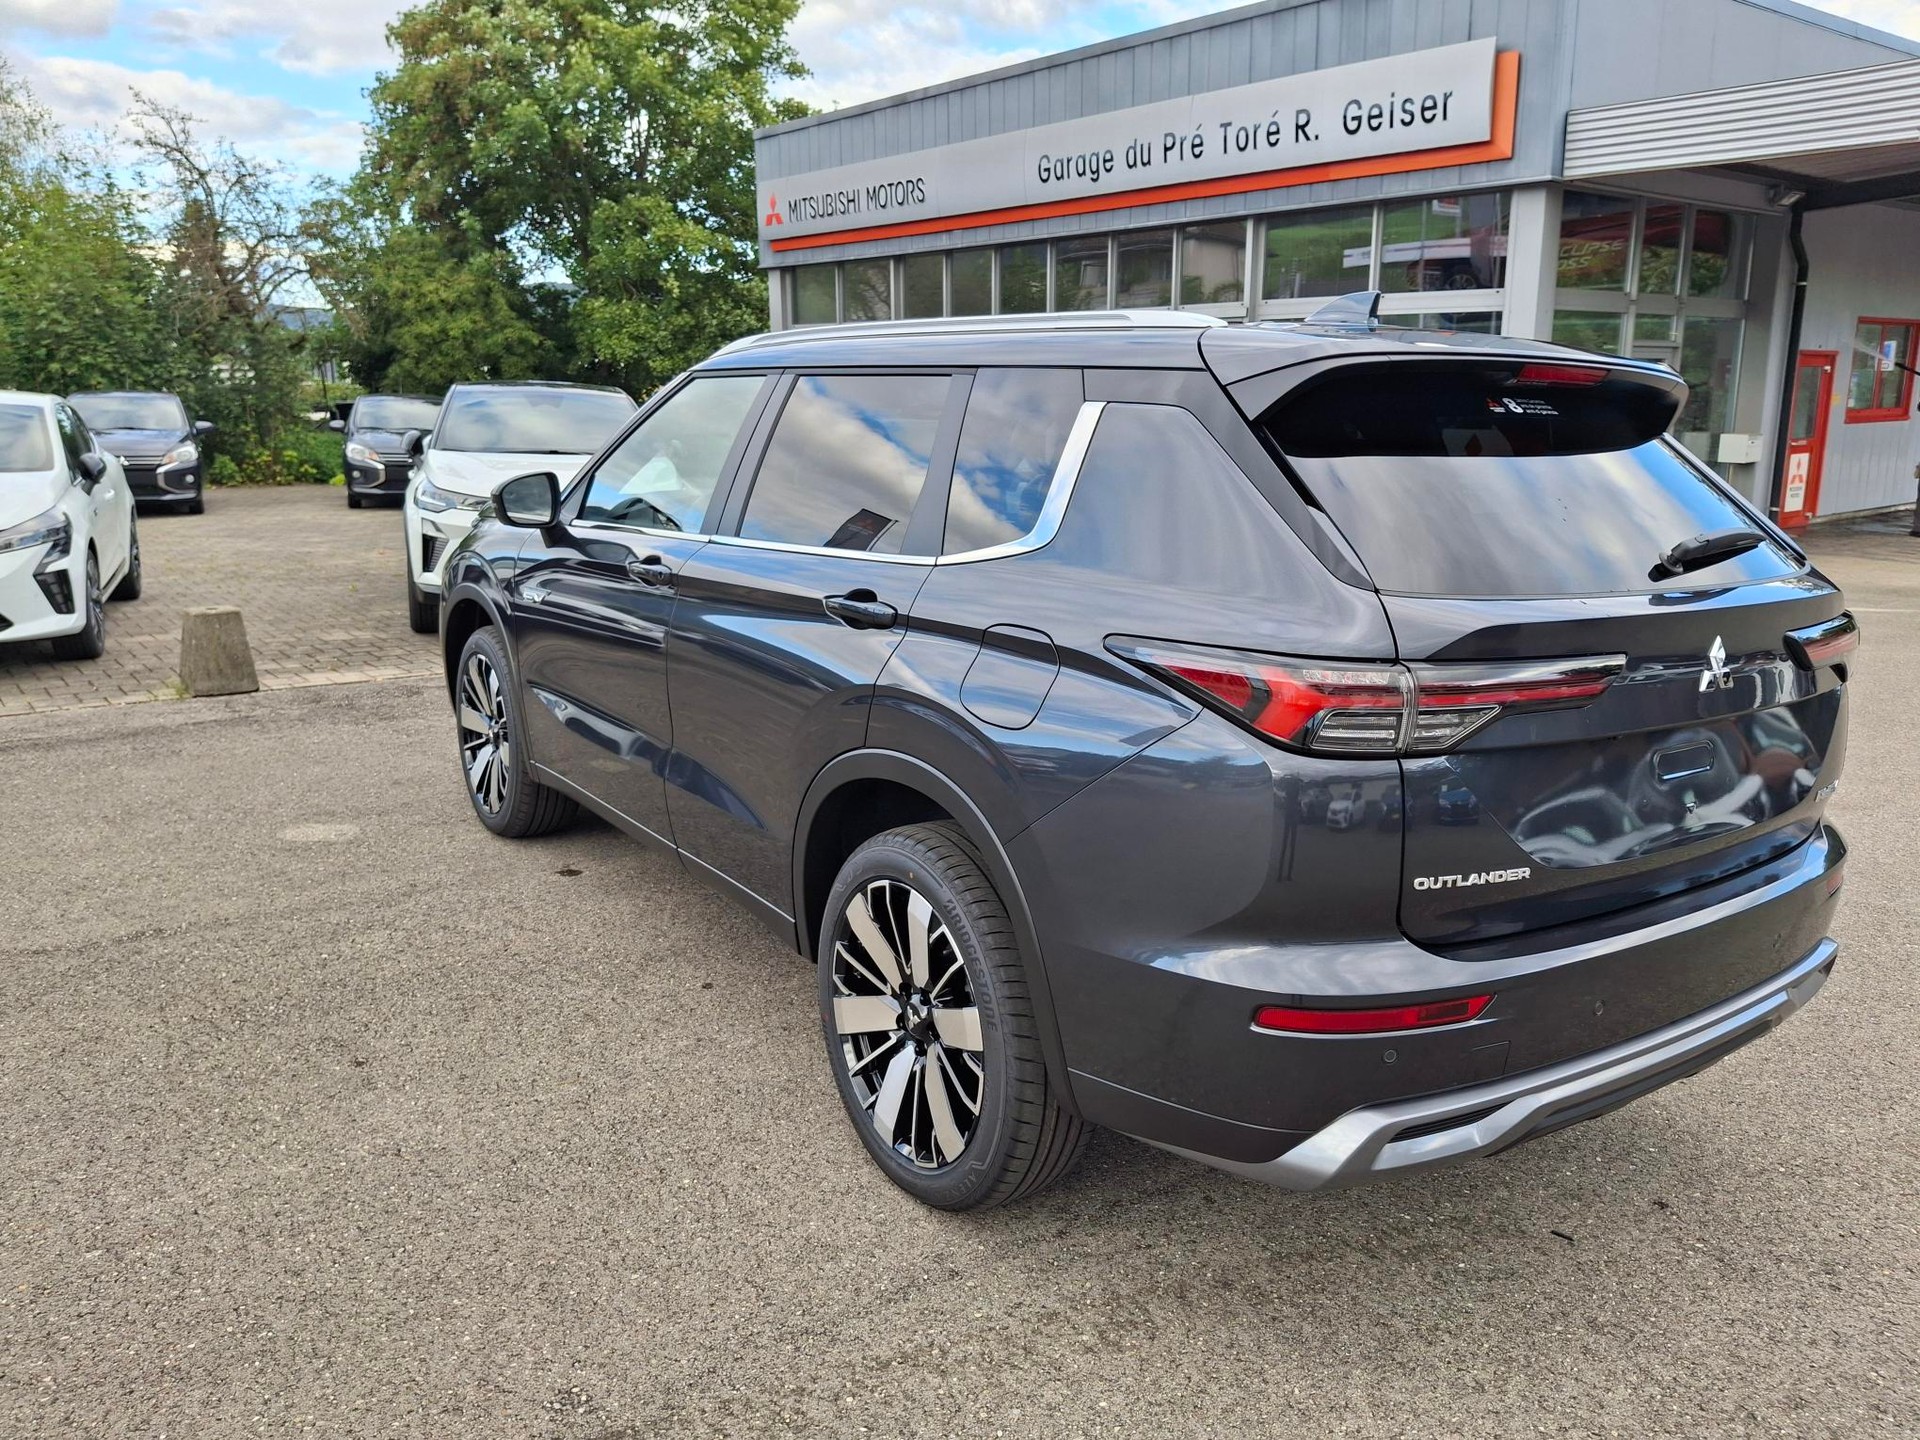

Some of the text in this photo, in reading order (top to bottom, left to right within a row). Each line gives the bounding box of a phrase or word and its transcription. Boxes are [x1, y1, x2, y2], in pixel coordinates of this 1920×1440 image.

[1038, 90, 1453, 183] Garage du Pré Toré R. Geiser
[788, 177, 926, 223] MITSUBISHI MOTORS
[1560, 239, 1624, 257] CLIPSE
[1502, 397, 1524, 413] 8
[1413, 867, 1531, 890] OUTLANDER
[943, 898, 998, 1032] BRIDGESTONE
